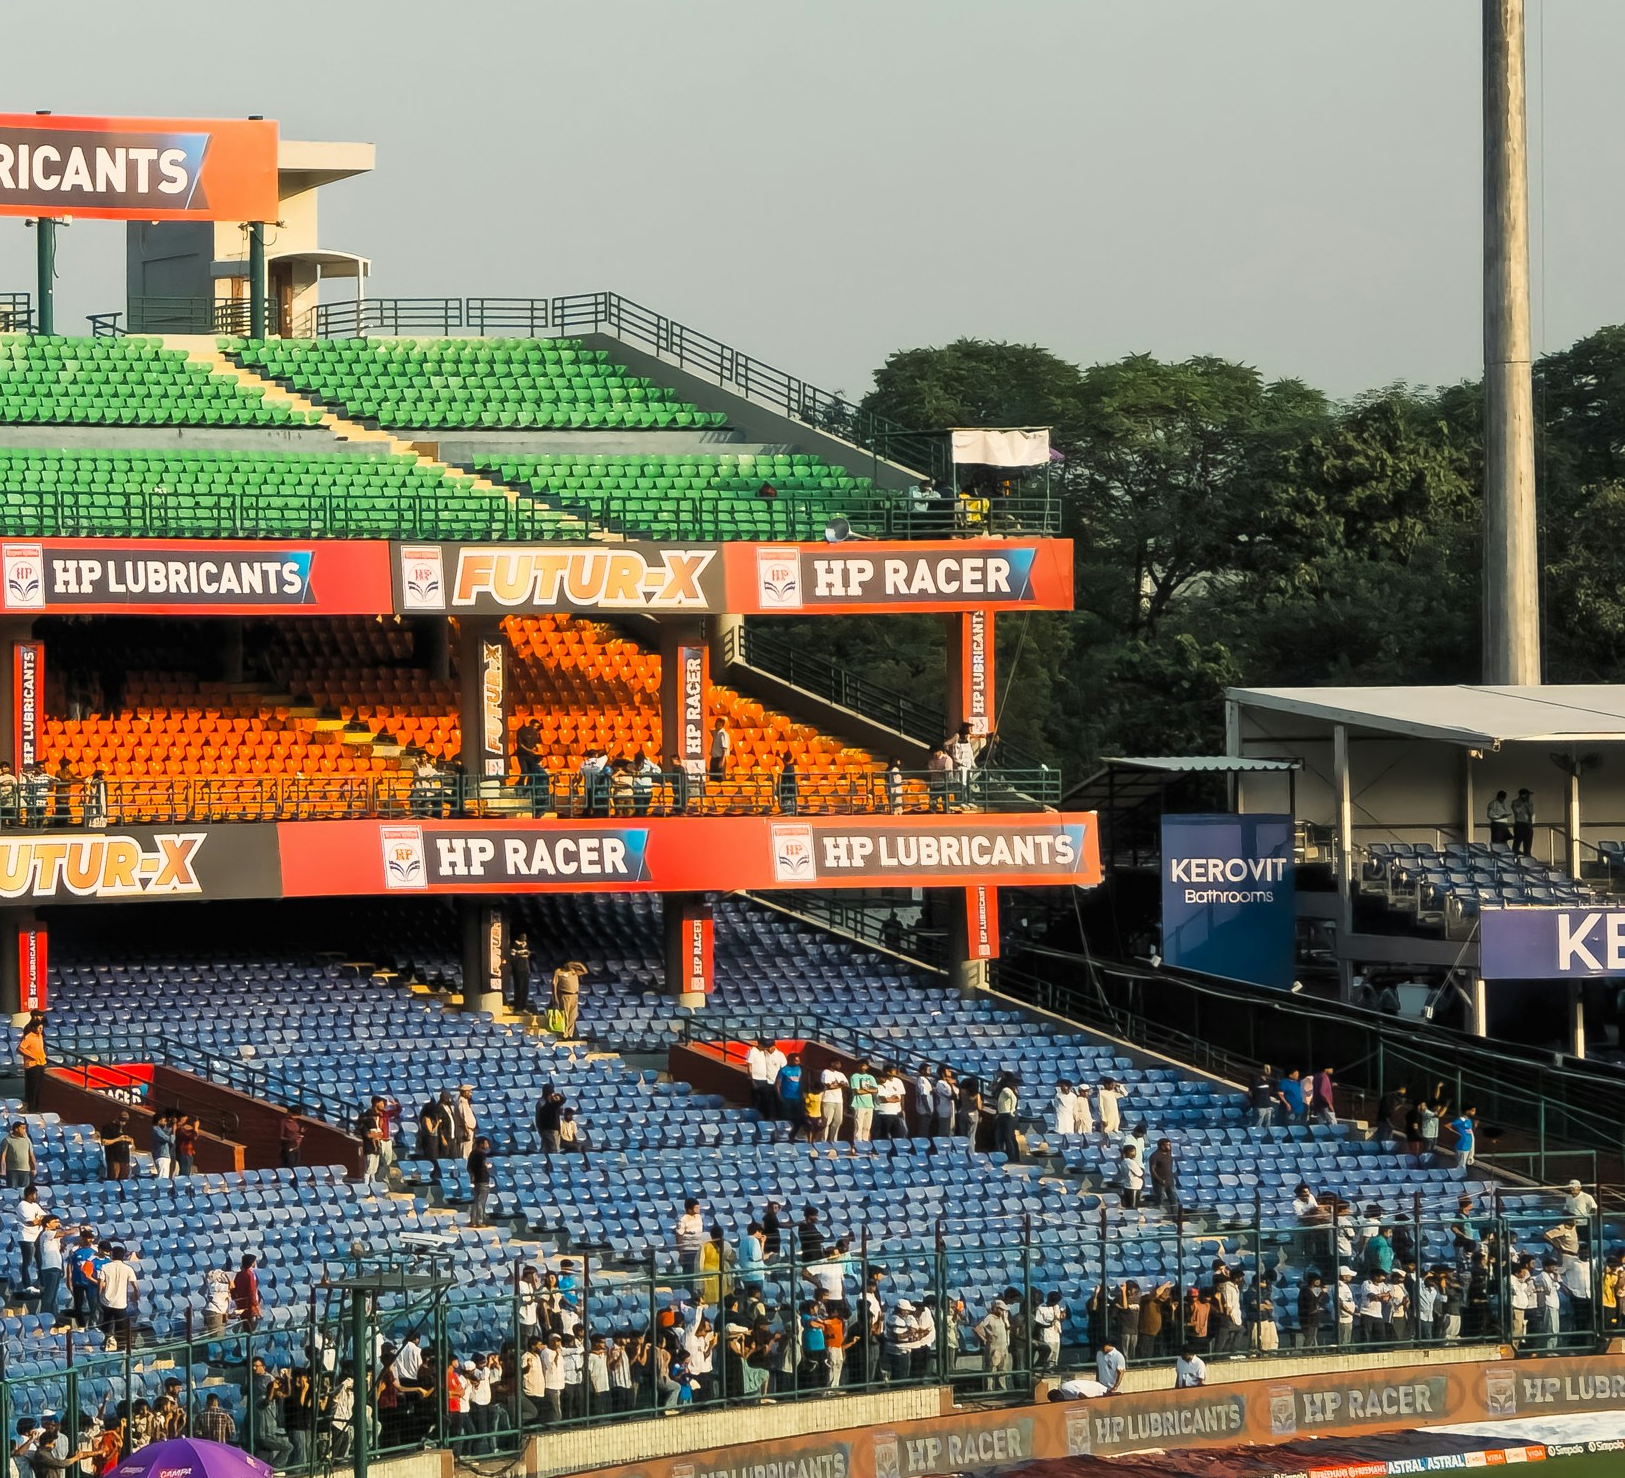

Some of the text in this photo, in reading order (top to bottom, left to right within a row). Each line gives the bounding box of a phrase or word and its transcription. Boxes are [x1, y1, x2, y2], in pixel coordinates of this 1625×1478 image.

[53, 560, 302, 594] HP LUBRICANTS
[455, 551, 711, 604] FUTUR-X
[813, 558, 1011, 596] HP RACER
[23, 651, 35, 764] HP LUBRICANTS
[686, 658, 702, 754] HP RACER
[435, 837, 628, 876] HP RACER
[823, 834, 1074, 868] HP LUBRICANTS
[1171, 858, 1286, 883] KEROVIT
[1185, 888, 1274, 904] Bathrooms
[1303, 1384, 1433, 1423] HP RACER
[1523, 1378, 1561, 1403] HP
[1095, 1404, 1240, 1444] HP LUBRICANTS
[904, 1428, 1022, 1472] HP RACER
[1427, 1454, 1464, 1470] ASTRAL
[1555, 1444, 1583, 1456] Simpolo
[1596, 1440, 1625, 1452] Simpolo
[160, 1468, 192, 1478] CAMPA
[1388, 1458, 1425, 1475] ASTRAL
